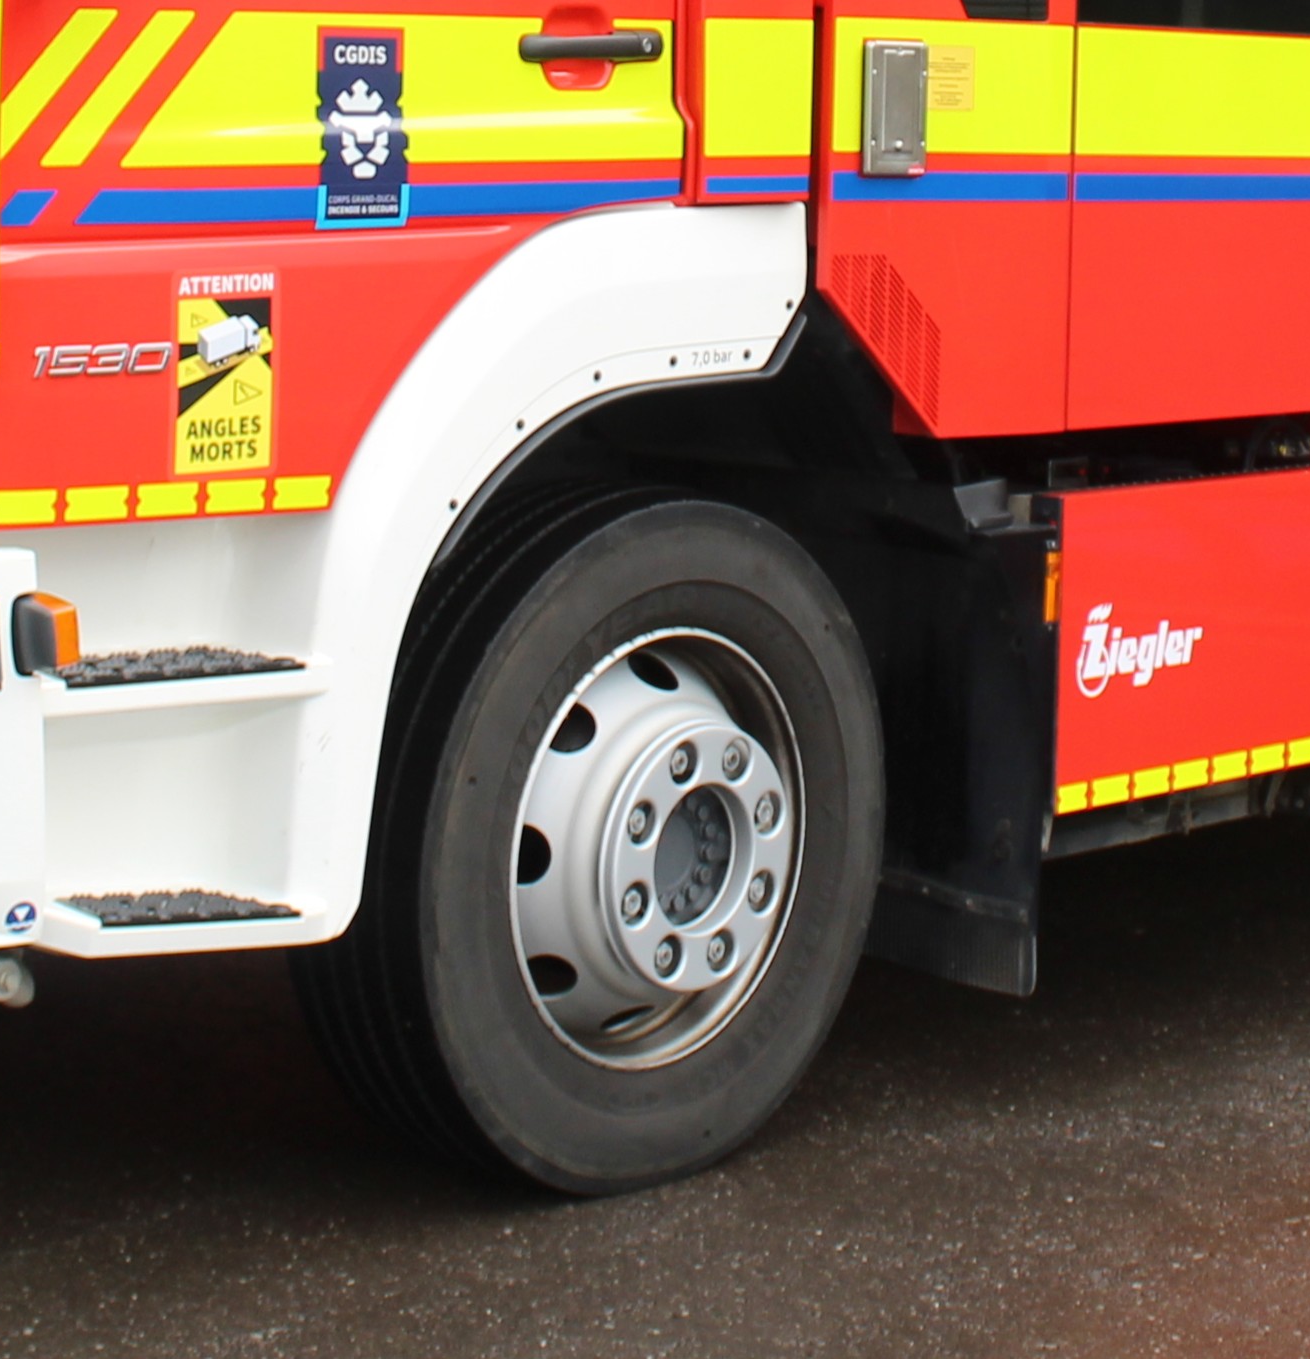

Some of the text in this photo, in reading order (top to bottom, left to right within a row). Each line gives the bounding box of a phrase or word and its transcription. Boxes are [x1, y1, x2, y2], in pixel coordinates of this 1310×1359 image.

[334, 44, 388, 65] CGDIS
[178, 273, 275, 296] ATTENTION
[33, 342, 173, 379] 1530
[691, 349, 733, 368] 7,0 bar
[186, 414, 262, 441] ANGLES
[189, 439, 257, 464] MORTS
[1076, 606, 1203, 698] Ziegler
